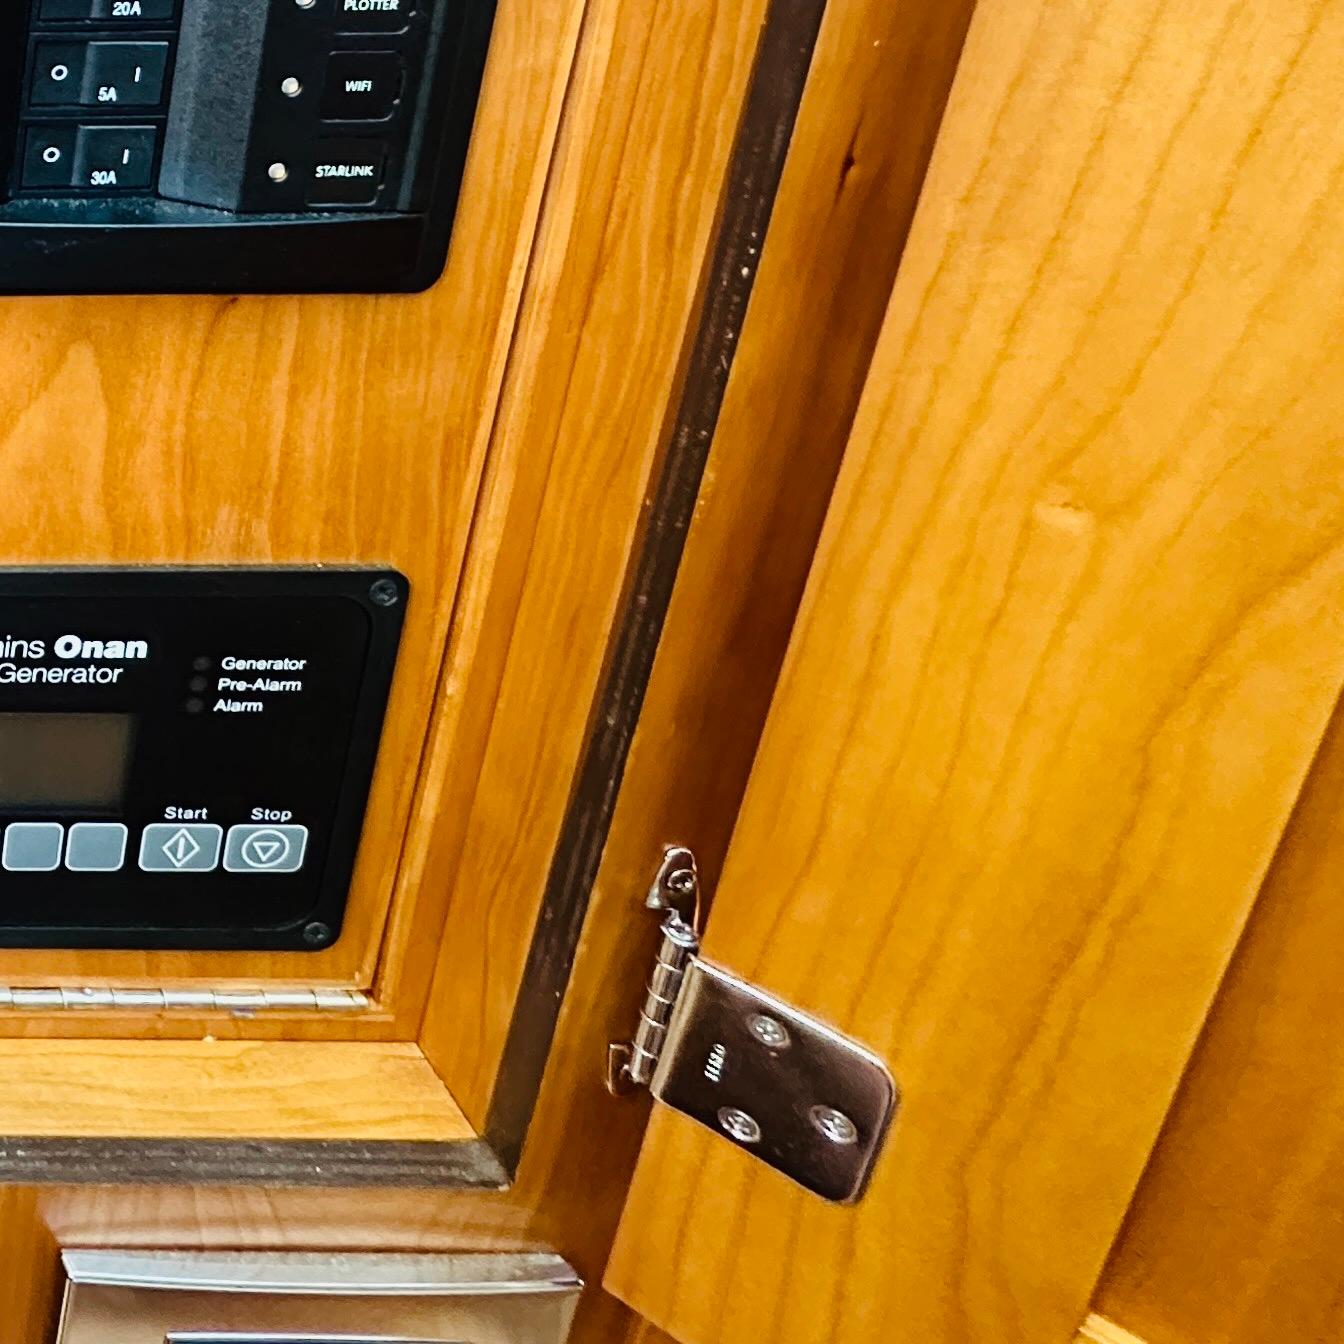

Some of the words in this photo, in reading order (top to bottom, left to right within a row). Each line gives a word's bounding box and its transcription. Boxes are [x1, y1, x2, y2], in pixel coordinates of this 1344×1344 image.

[345, 80, 371, 92] WIFI
[315, 165, 373, 178] STARLINK
[53, 636, 147, 659] Onan
[221, 656, 306, 671] Generator
[217, 678, 302, 693] Pre-Alarm
[214, 699, 263, 713] Alarm
[164, 806, 208, 821] Start
[250, 807, 293, 823] Stop
